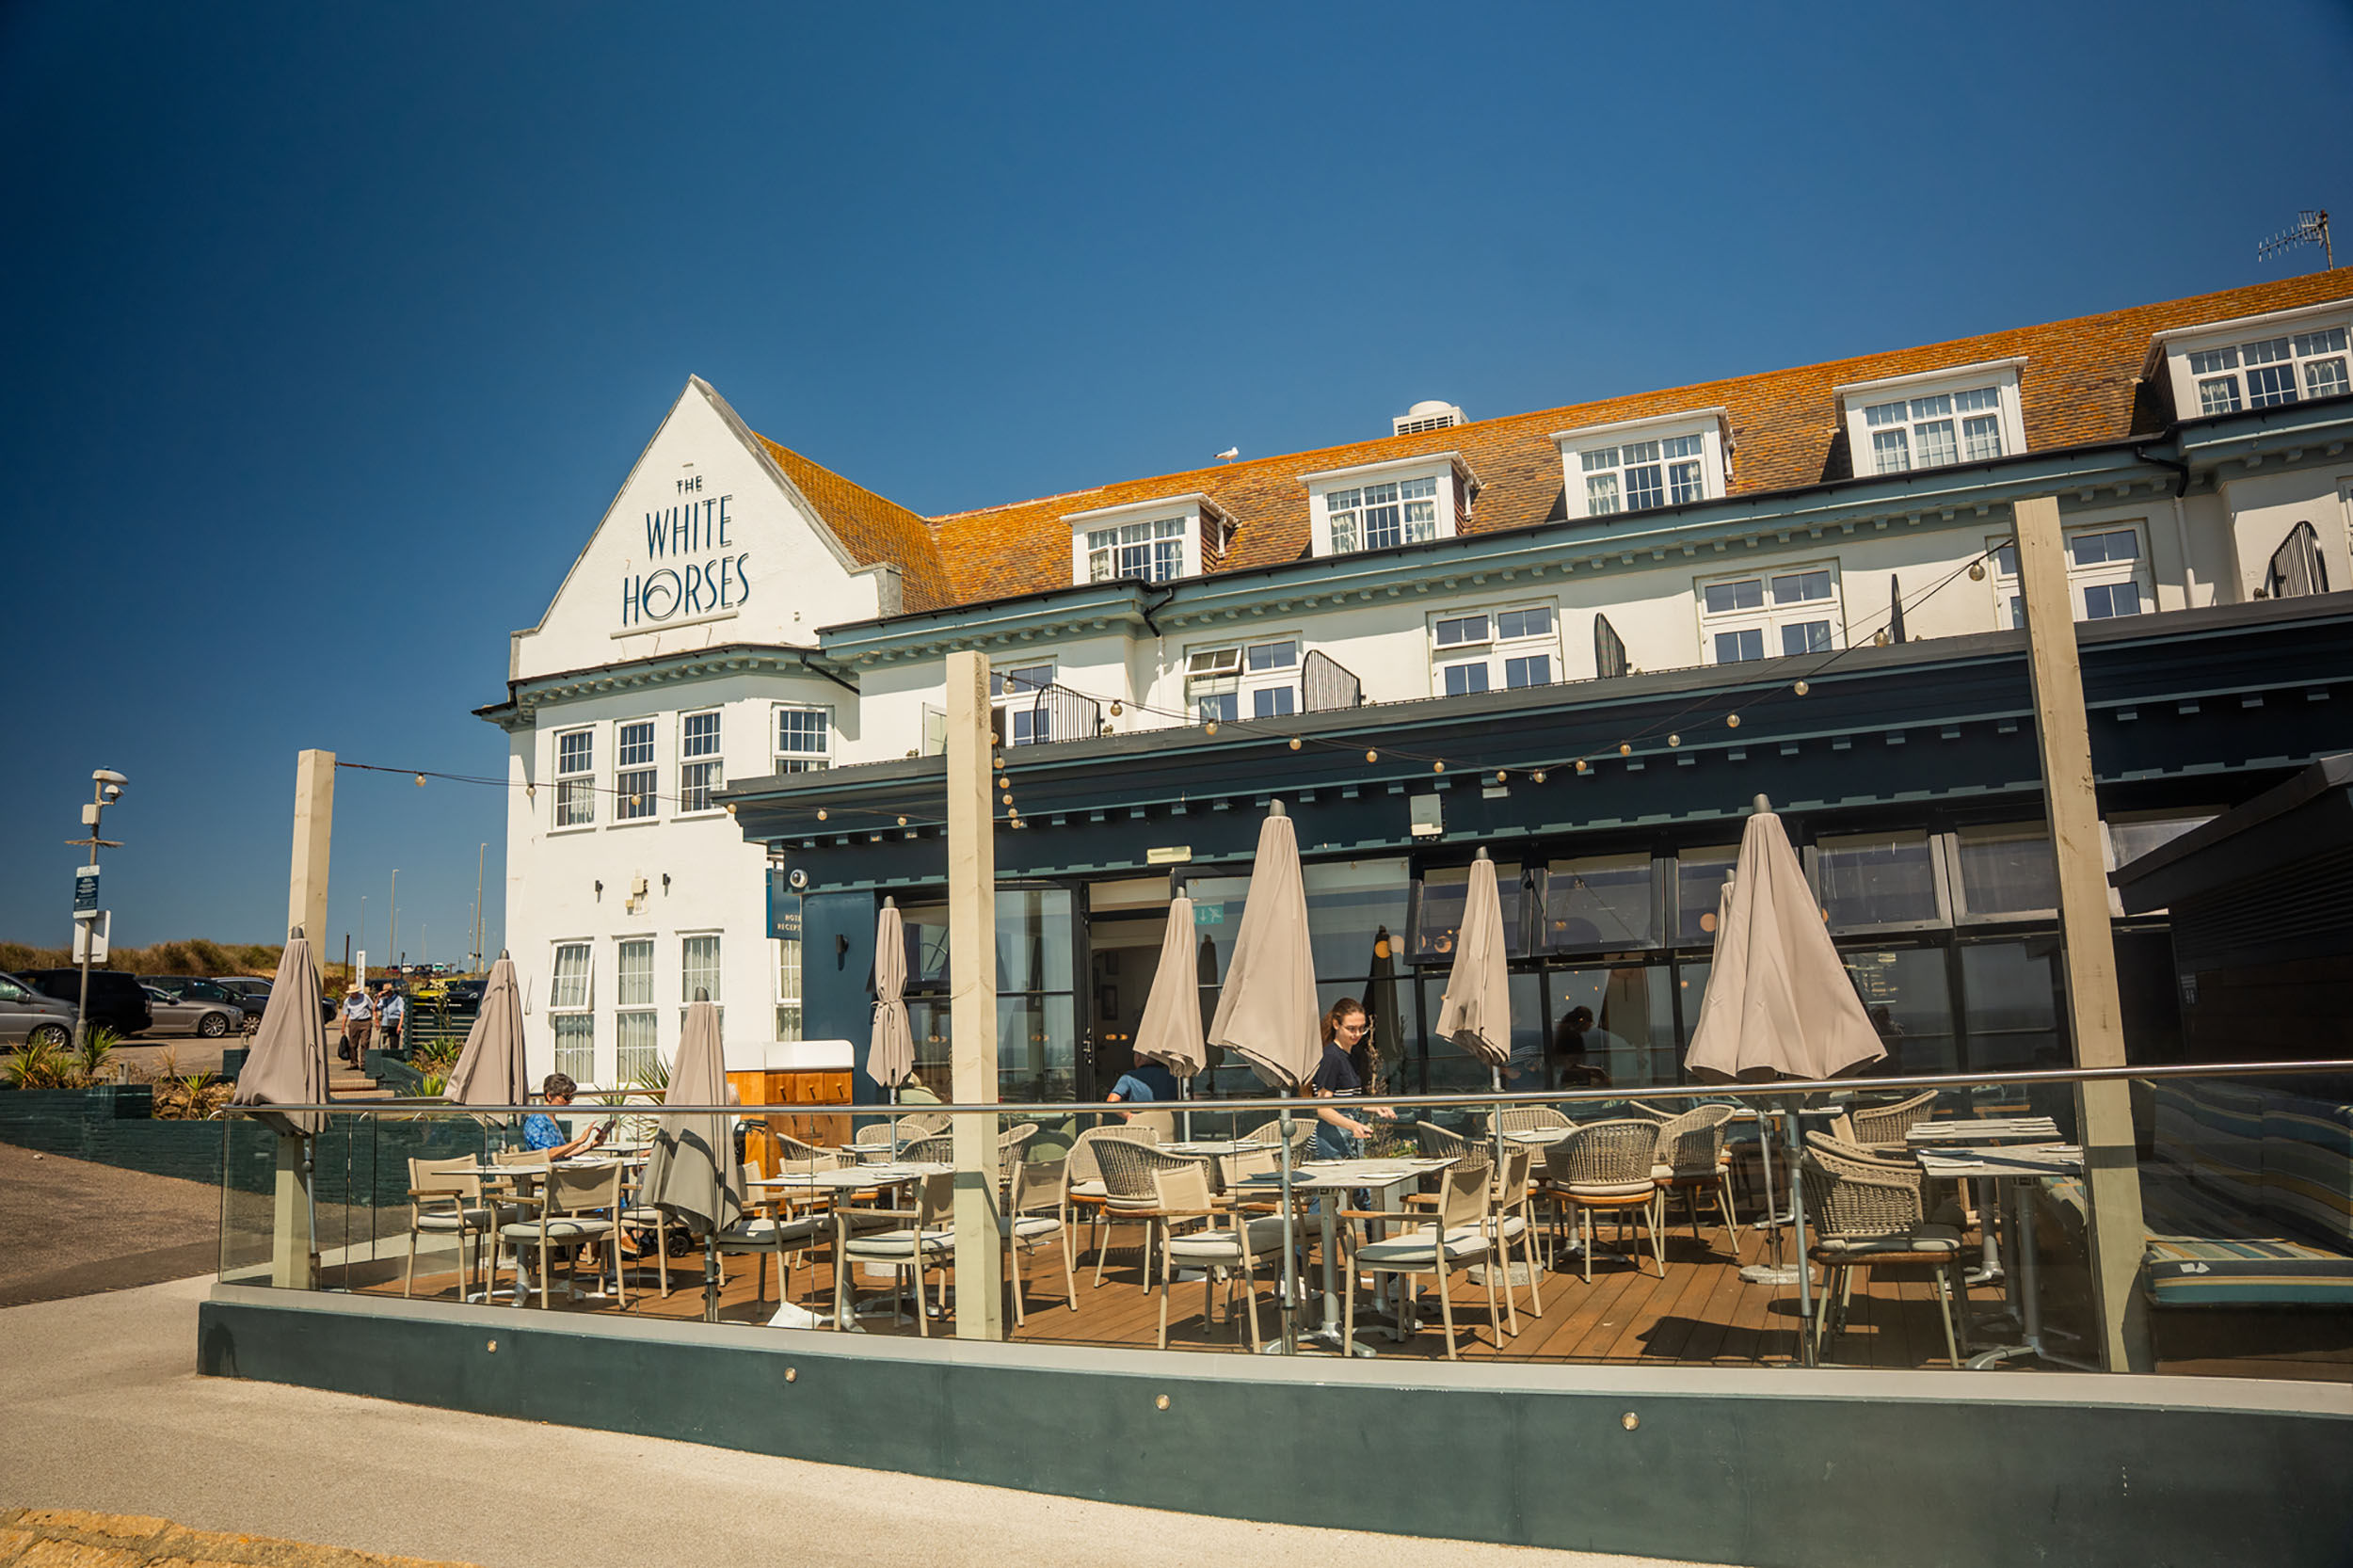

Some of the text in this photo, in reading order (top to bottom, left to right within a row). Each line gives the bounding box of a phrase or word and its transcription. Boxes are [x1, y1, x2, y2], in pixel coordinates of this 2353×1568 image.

[677, 475, 702, 496] THE
[646, 494, 732, 562] WHITE
[623, 552, 749, 627] HORSES
